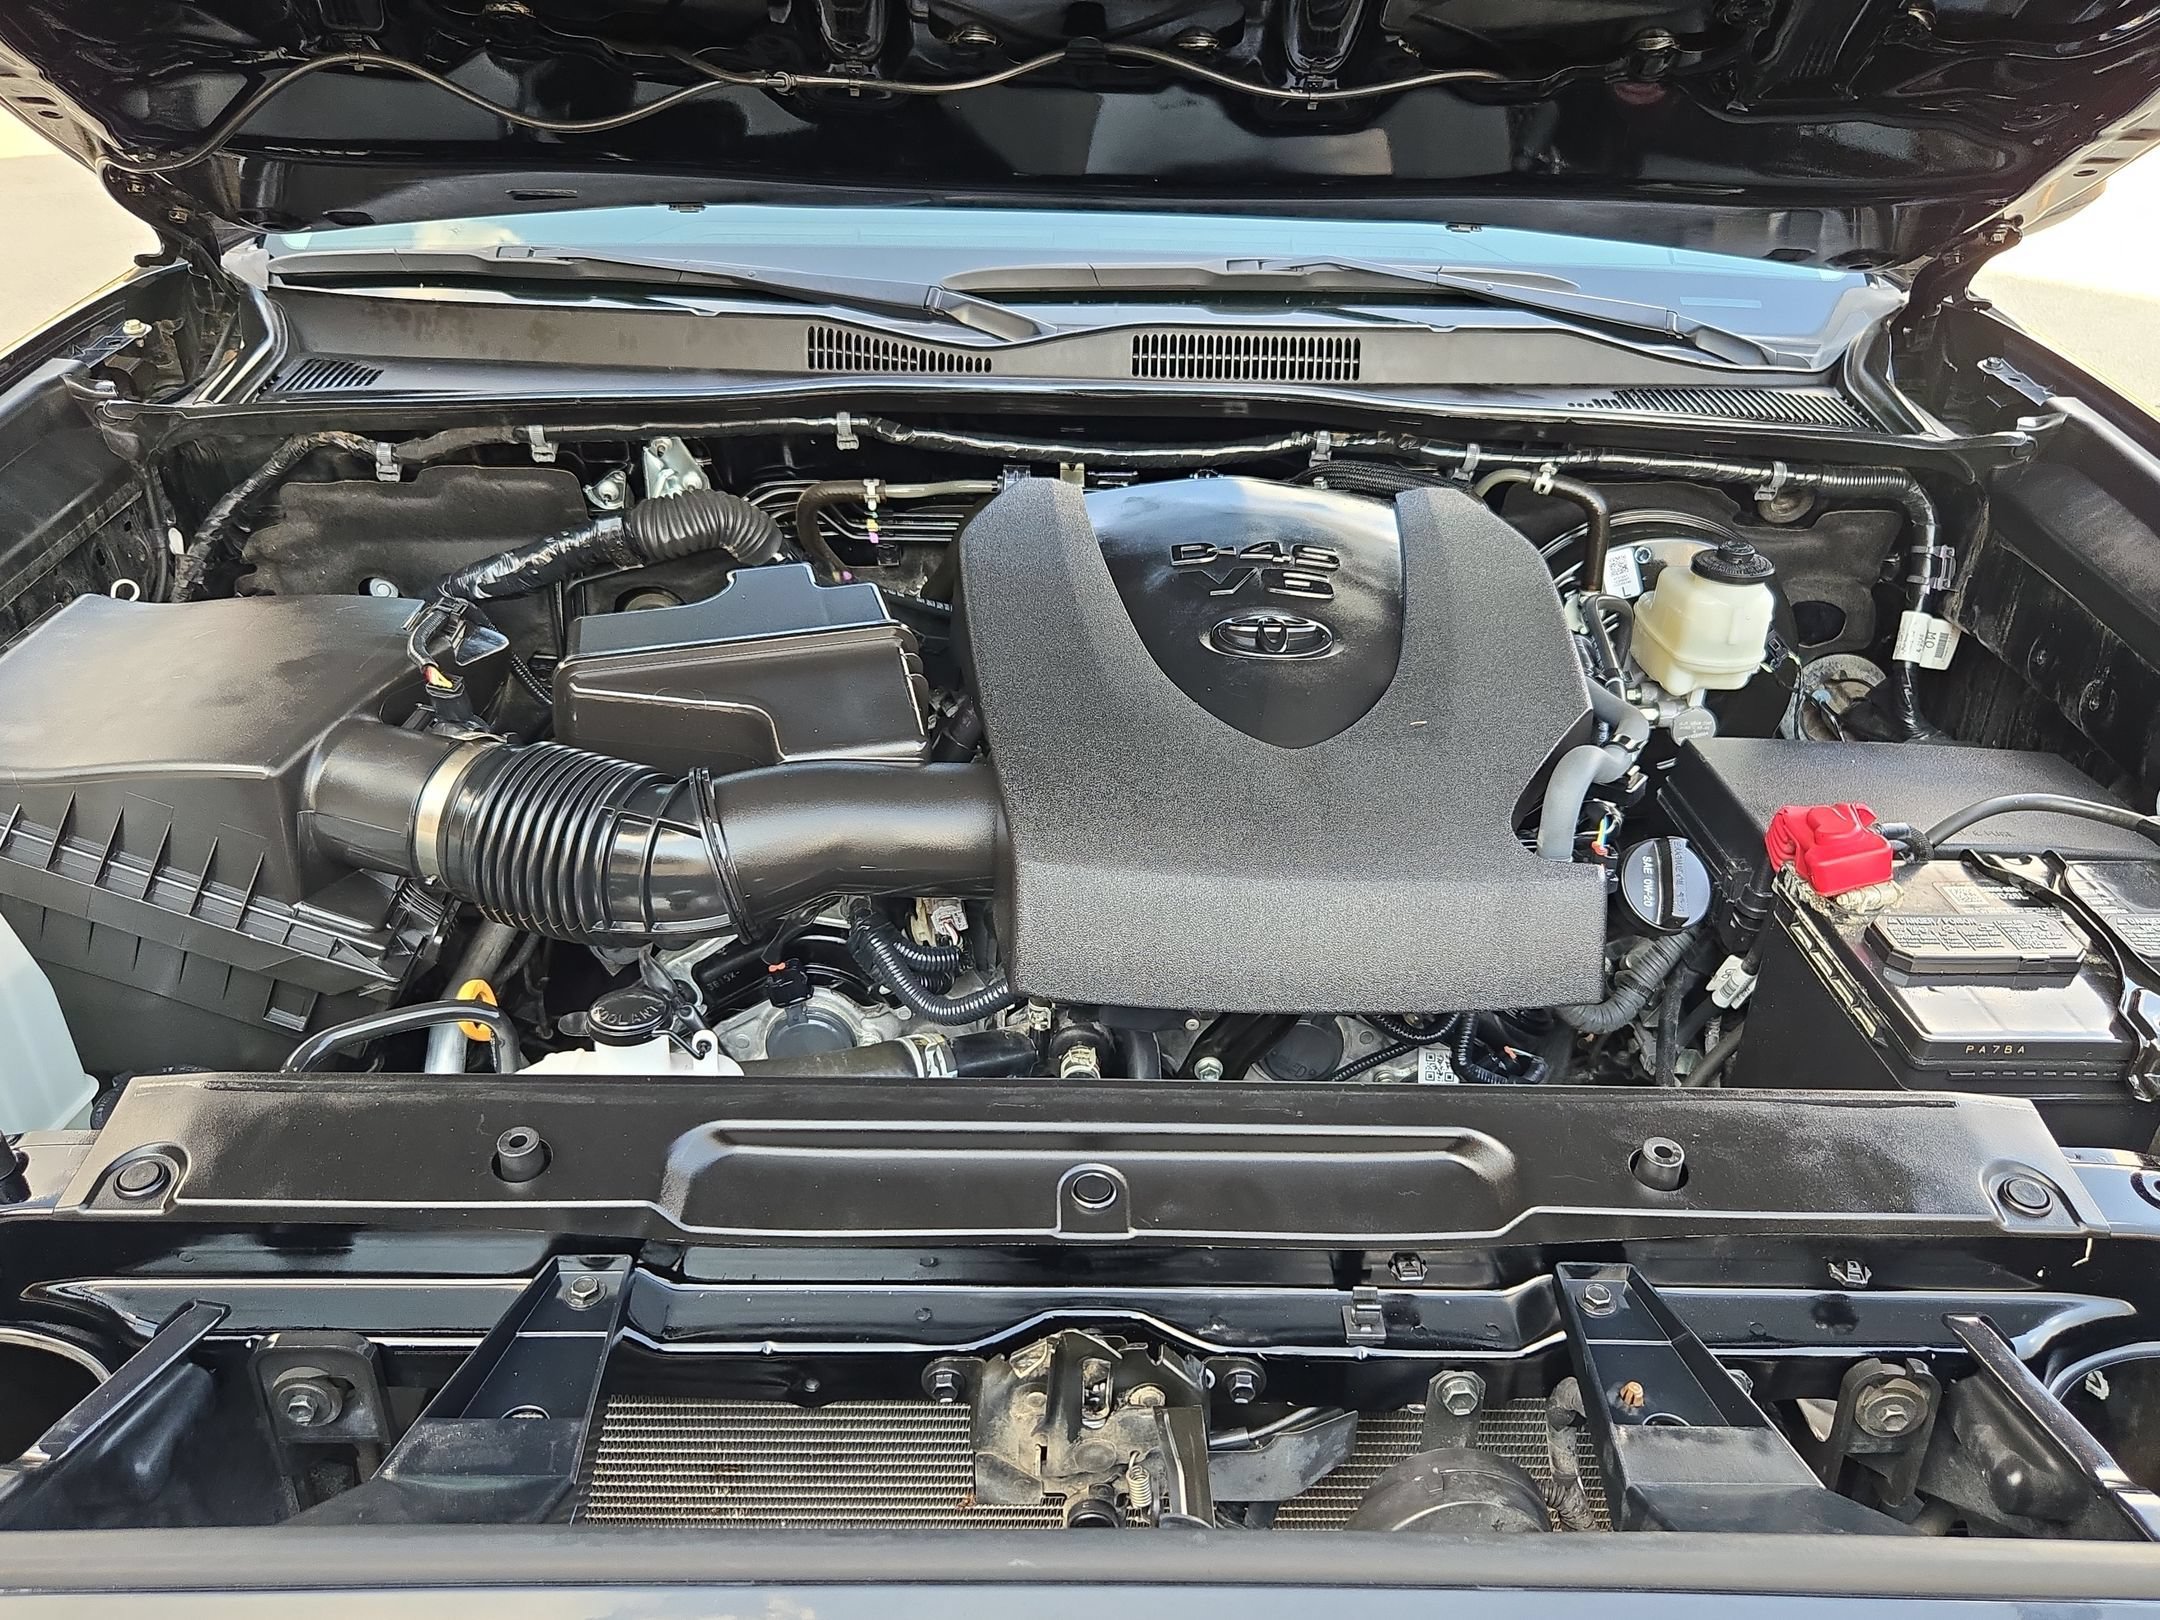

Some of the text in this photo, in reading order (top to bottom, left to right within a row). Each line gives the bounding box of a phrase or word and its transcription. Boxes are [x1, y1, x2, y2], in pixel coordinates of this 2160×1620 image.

[1170, 541, 1341, 570] D-4S
[1178, 567, 1335, 600] V6
[1642, 855, 1655, 907] SAE 0W-20
[593, 1005, 659, 1025] COOLANT
